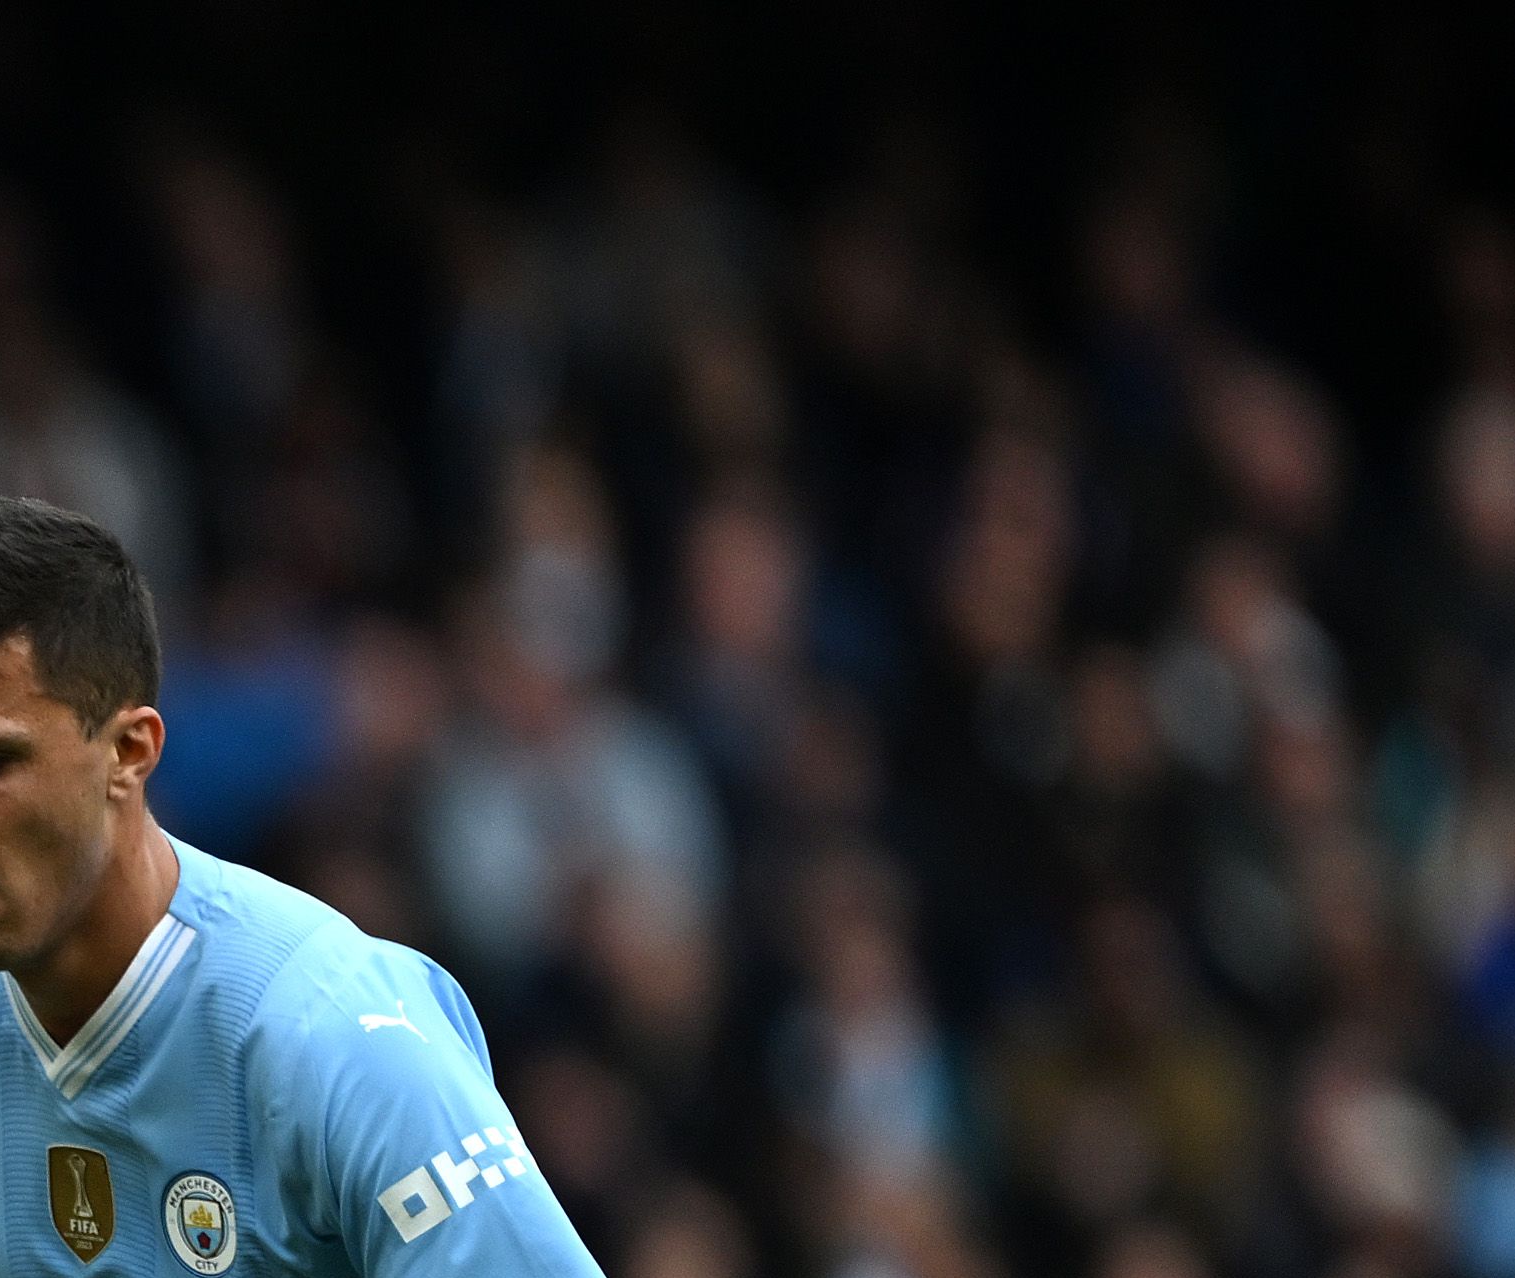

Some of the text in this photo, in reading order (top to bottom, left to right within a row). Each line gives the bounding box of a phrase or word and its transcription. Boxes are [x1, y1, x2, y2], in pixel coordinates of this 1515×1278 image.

[169, 1178, 235, 1214] MANCHESTER
[69, 1218, 99, 1236] FIFA
[195, 1260, 219, 1271] CITY
